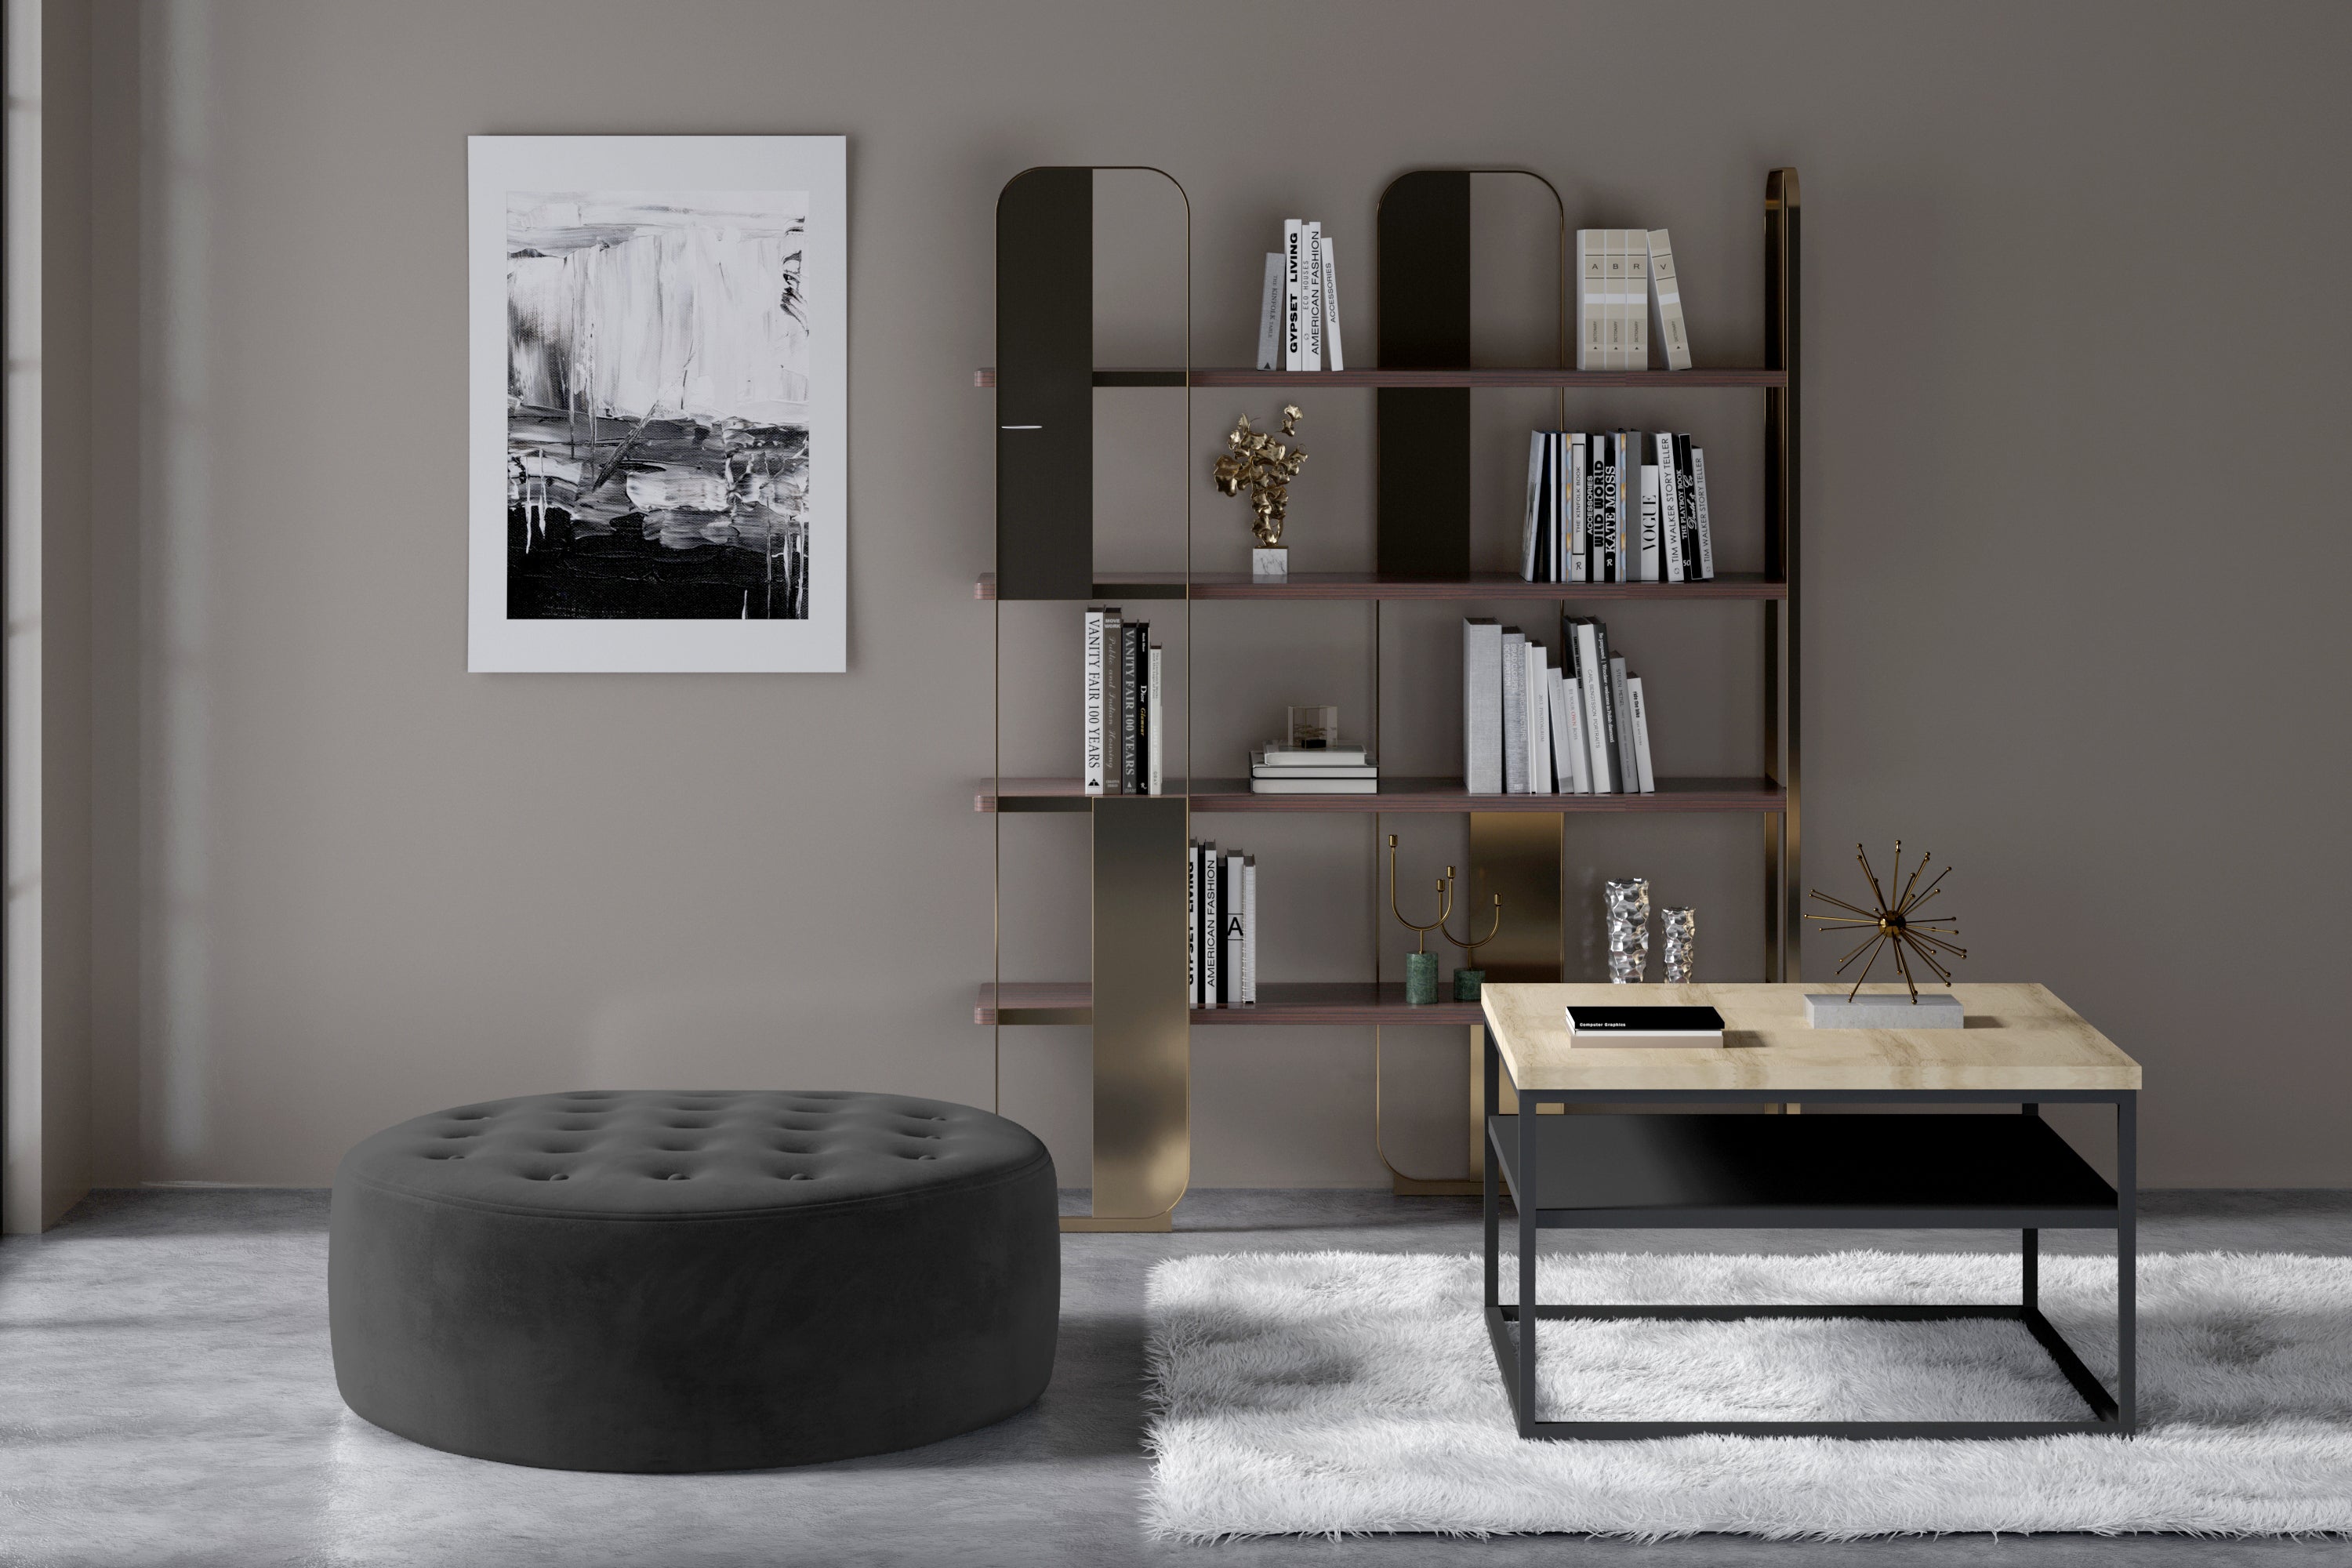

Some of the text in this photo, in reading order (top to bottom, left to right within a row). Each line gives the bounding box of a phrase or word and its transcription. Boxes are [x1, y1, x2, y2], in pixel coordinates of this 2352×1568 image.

[1326, 263, 1336, 322] ACCESSORIES
[1661, 438, 1671, 469] TELLER
[1595, 461, 1603, 547] WILD WORLD
[1606, 466, 1615, 554] KATE MOSS
[1642, 495, 1656, 551] VOGUE
[1668, 506, 1676, 543] WALKER
[1089, 619, 1100, 768] VANITY FAIR 100 YEARS
[1126, 630, 1134, 775] VANITY FAIR 100 YEARS
[1106, 730, 1116, 768] Housing
[1228, 917, 1243, 936] A
